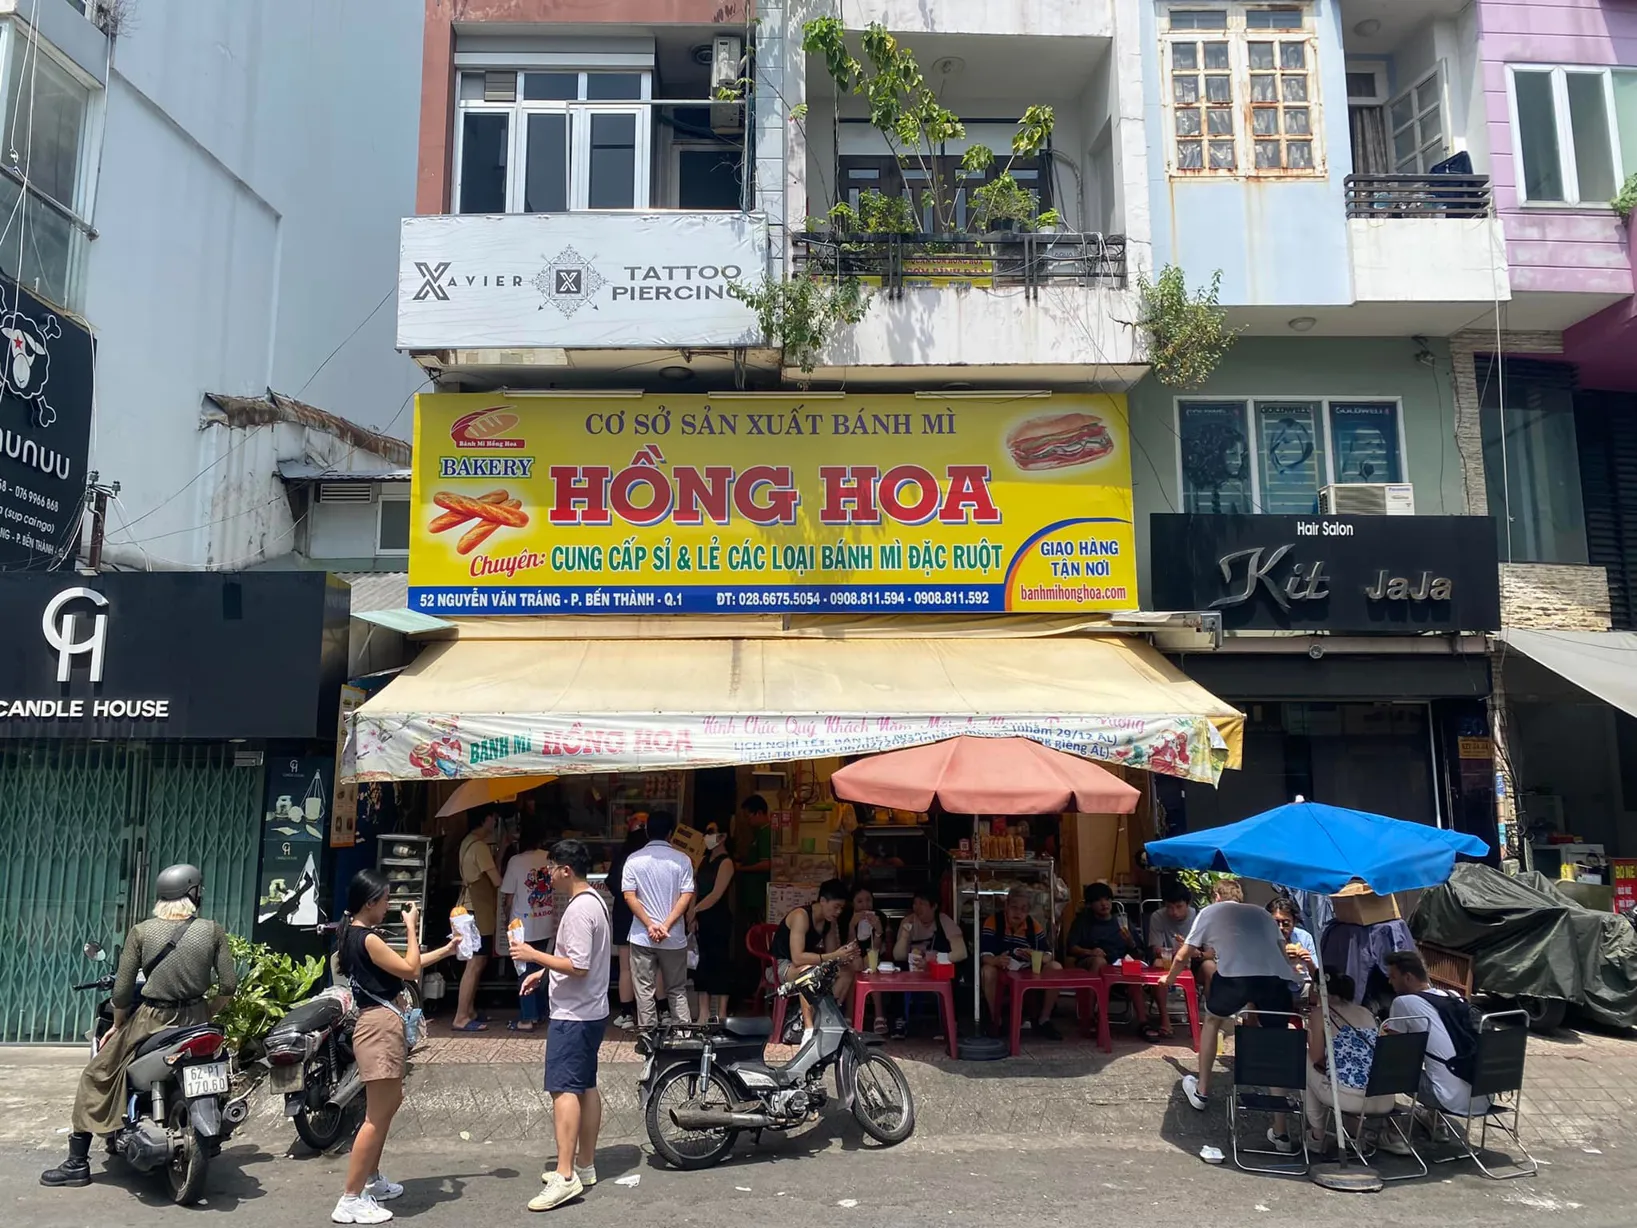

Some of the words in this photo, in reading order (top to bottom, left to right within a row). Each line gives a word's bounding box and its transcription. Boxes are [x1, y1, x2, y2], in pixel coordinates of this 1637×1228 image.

[623, 265, 742, 281] TATTOO
[585, 412, 626, 436] CƠ
[634, 406, 671, 436] SỞ
[681, 405, 739, 436] SẢN
[747, 405, 822, 436] XUẤT
[832, 408, 911, 435] BÁNH
[922, 407, 957, 435] MÌ
[441, 457, 534, 477] BAKERY
[549, 444, 801, 526] HỒNG
[819, 464, 1003, 526] HOA
[1297, 521, 1319, 536] Hair
[1322, 521, 1353, 536] Salon
[469, 548, 546, 578] Chuyên:
[551, 545, 603, 572] CUNG
[608, 536, 645, 572] CẤP
[652, 536, 672, 571] SỈ
[676, 545, 692, 572] &
[697, 536, 721, 571] LẺ
[728, 538, 767, 571] CÁC
[772, 544, 815, 576] LOẠI
[821, 538, 873, 571] BÁNH
[879, 538, 902, 571] MÌ
[908, 539, 947, 576] ĐẶC
[953, 538, 1003, 577] RUỘT
[1040, 541, 1074, 557] GIAO
[1079, 538, 1119, 556] HÀNG
[1051, 559, 1082, 578] TẬN
[1085, 560, 1110, 576] NƠI
[1208, 543, 1330, 614] Kit
[420, 593, 435, 607] 52
[437, 587, 488, 607] NGUYỄN
[491, 589, 517, 607] VĂN
[519, 588, 561, 607] TRÁNG
[571, 593, 582, 607] P.
[585, 589, 611, 607] BẾN
[612, 588, 654, 607] THÀNH
[664, 593, 683, 607] Q.1
[716, 592, 736, 606] ĐT:
[738, 592, 821, 606] 028.6675.5054
[830, 591, 905, 605] 0908.811.594
[914, 591, 989, 605] 0908.811.592
[1020, 584, 1127, 603] banhmihonghoa.com
[0, 700, 84, 717] CANDLE
[93, 700, 169, 717] HOUSE
[744, 715, 778, 734] Chúc
[785, 715, 816, 738] Quý
[825, 715, 868, 734] Khách
[469, 734, 510, 764] BÁNH
[513, 727, 532, 755] MÌ
[542, 721, 626, 756] HỒNG
[633, 728, 694, 754] HOA
[1056, 727, 1093, 741] 29/12
[1097, 732, 1118, 747] ÂL)
[1091, 743, 1110, 760] ÂL)
[188, 1078, 225, 1095] 170.60
